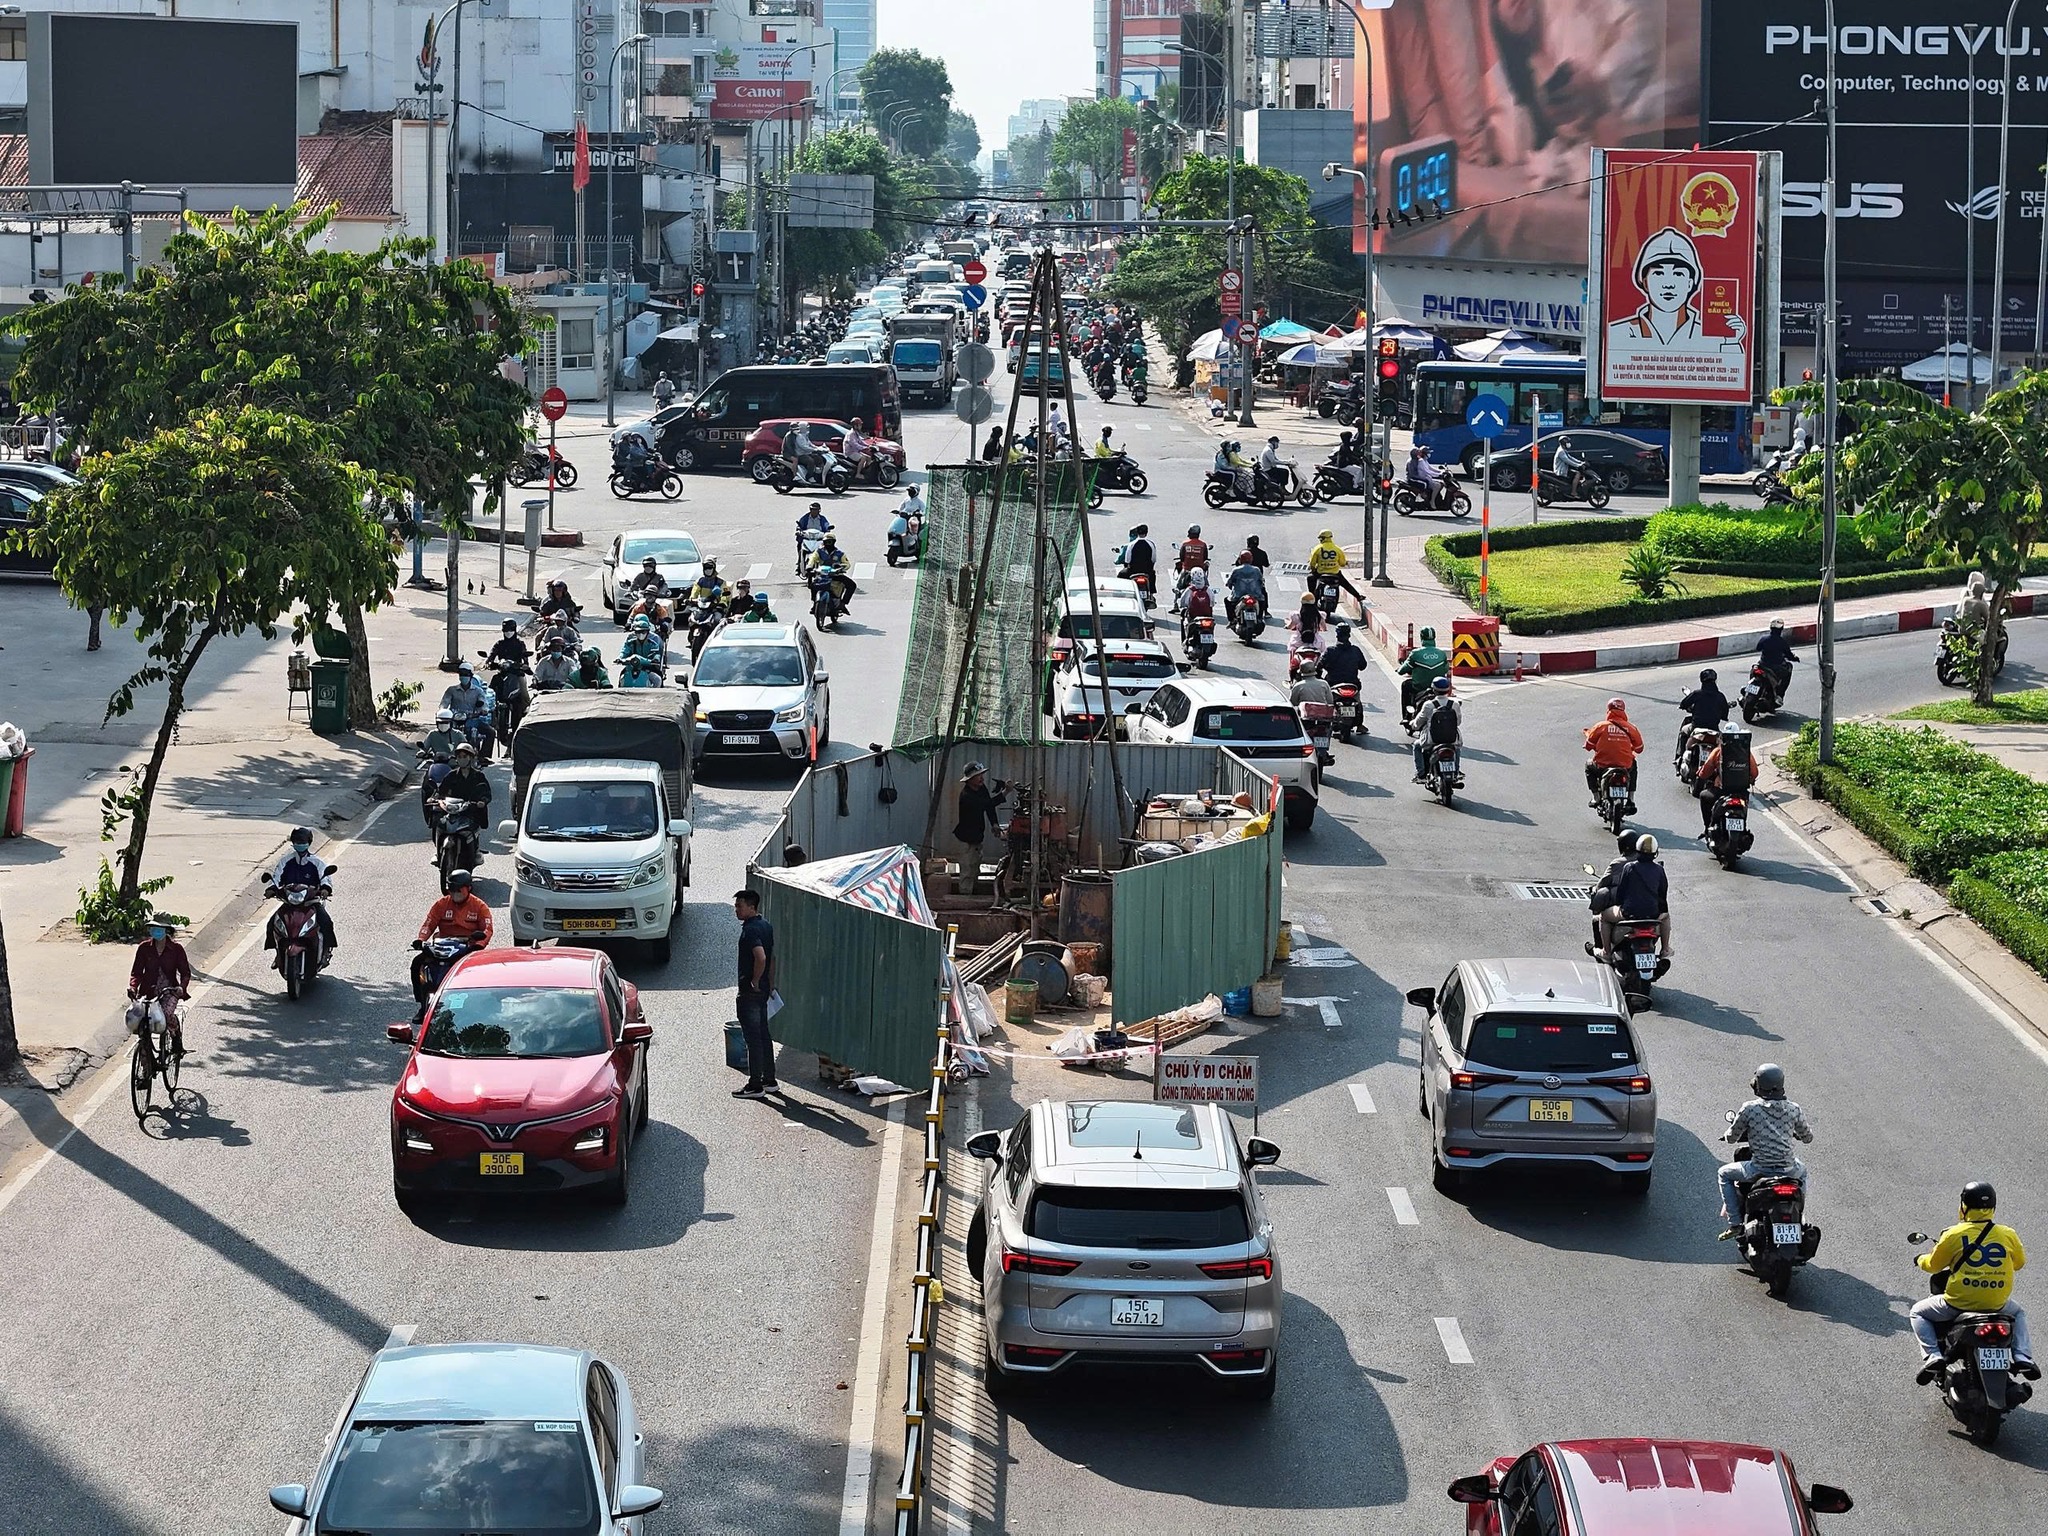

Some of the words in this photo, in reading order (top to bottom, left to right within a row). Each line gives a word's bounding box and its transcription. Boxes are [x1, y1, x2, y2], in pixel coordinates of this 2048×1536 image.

[2016, 75, 2030, 91] &
[1611, 165, 1688, 268] XVI
[1423, 294, 1580, 331] PHONGVU.VN
[1320, 548, 1337, 560] be
[1165, 1060, 1189, 1078] CHÚ
[1193, 1060, 1201, 1079] Ý
[1204, 1064, 1216, 1079] ĐI
[1219, 1062, 1253, 1084] CHẬM
[1162, 1083, 1179, 1100] CÔNG
[1180, 1083, 1205, 1100] TRƯỜNG
[1207, 1086, 1224, 1101] ĐANG
[1226, 1087, 1236, 1101] THI
[1237, 1084, 1255, 1101] CÔNG
[1542, 1101, 1561, 1110] 50G
[1534, 1111, 1569, 1120] 015.18
[492, 1154, 511, 1164] 50E
[485, 1164, 519, 1174] 390.08
[1776, 1226, 1796, 1234] 81-P1
[1962, 1236, 2007, 1268] be
[1128, 1300, 1150, 1312] 15C
[1116, 1312, 1159, 1325] 467.12
[1980, 1359, 2009, 1369] 507.15
